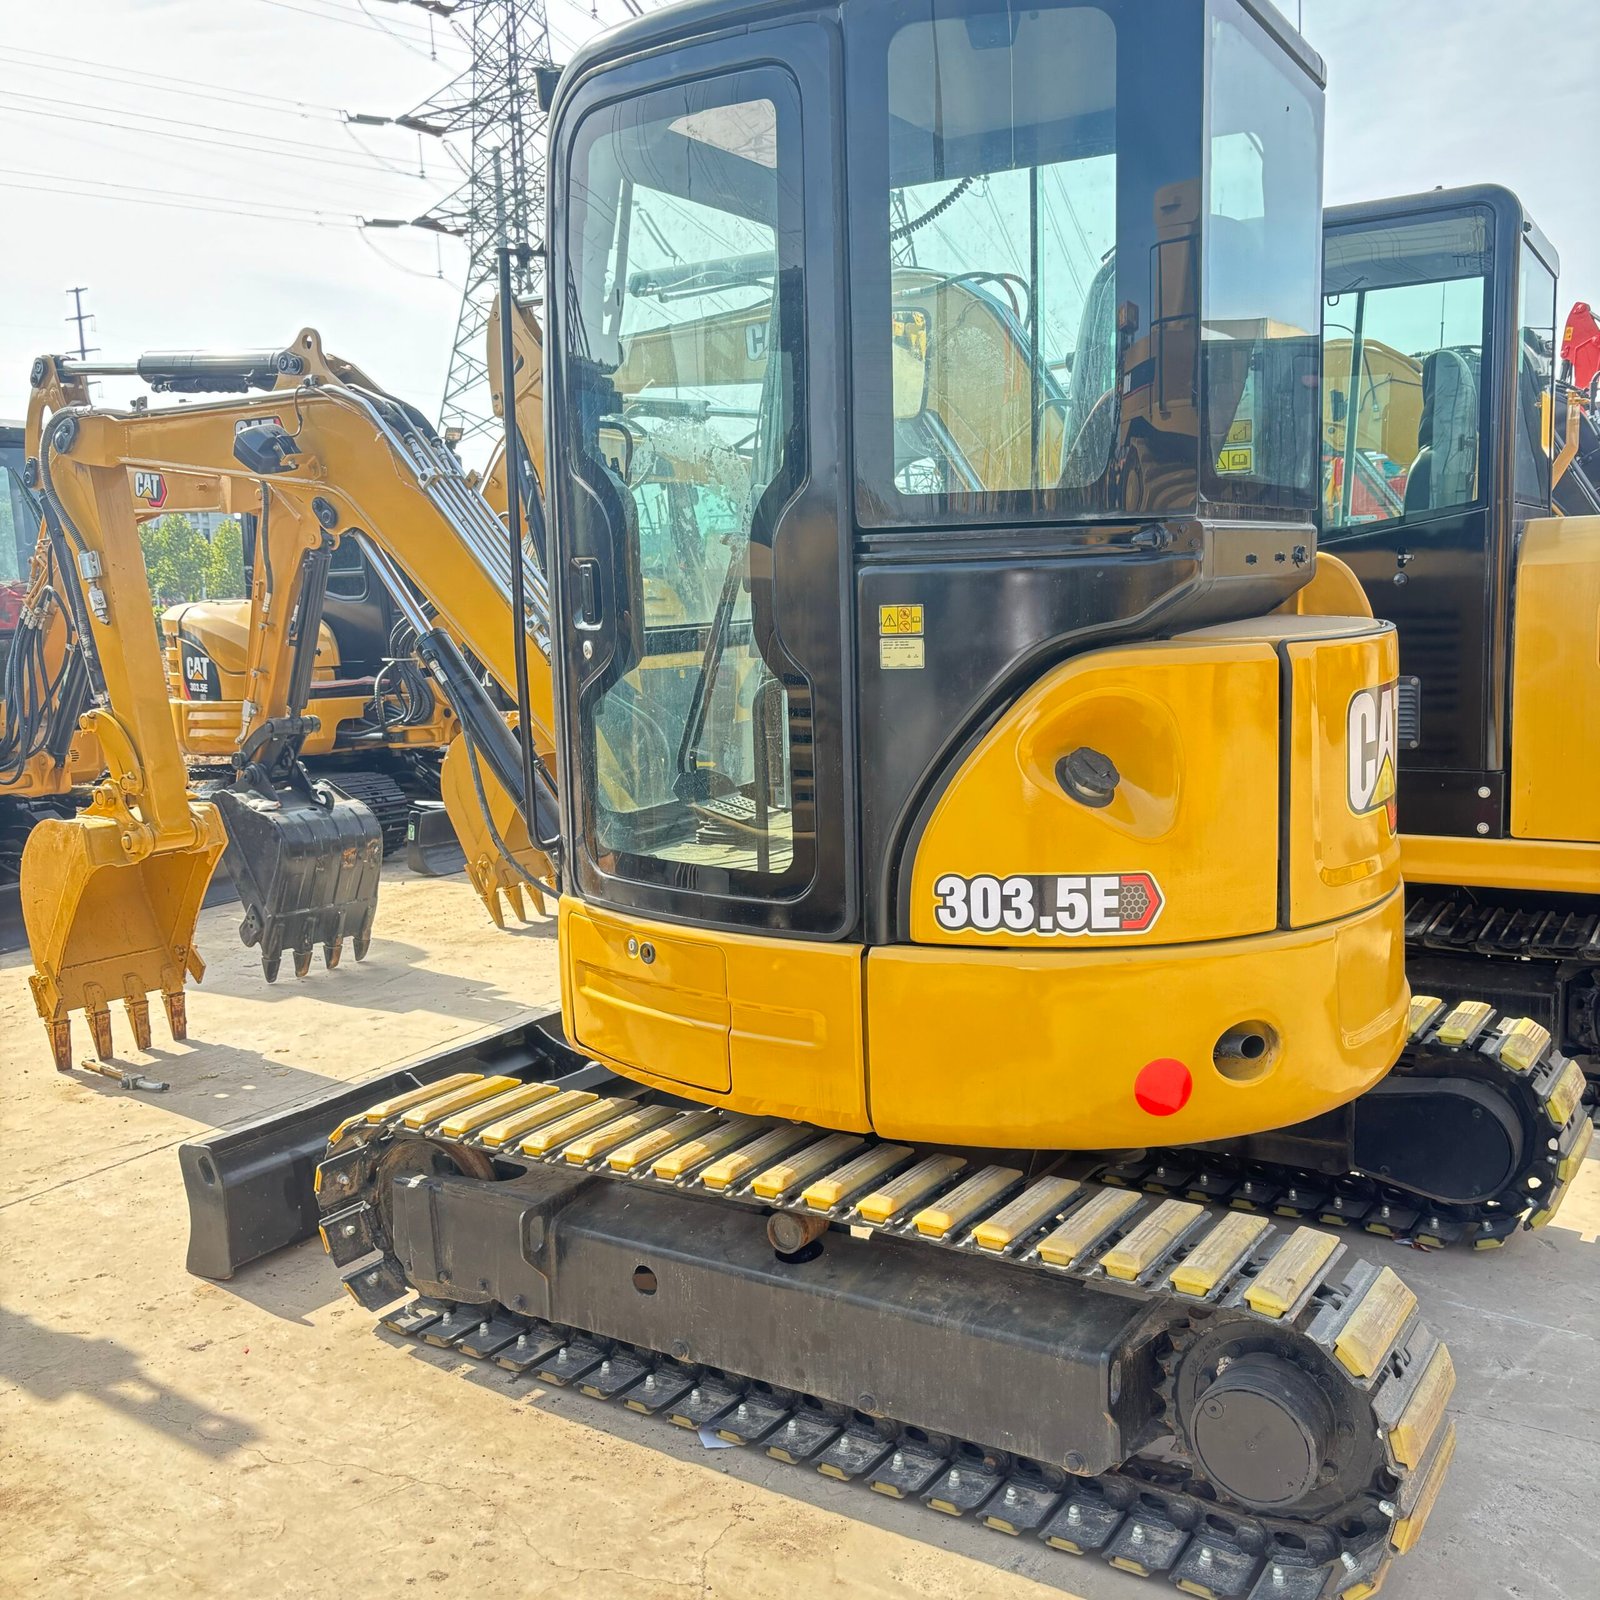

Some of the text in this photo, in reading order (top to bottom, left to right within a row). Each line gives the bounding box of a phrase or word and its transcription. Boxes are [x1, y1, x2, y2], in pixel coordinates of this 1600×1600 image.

[135, 472, 160, 499] CAT
[186, 656, 210, 680] CAT
[937, 876, 1120, 930] 303.5E
